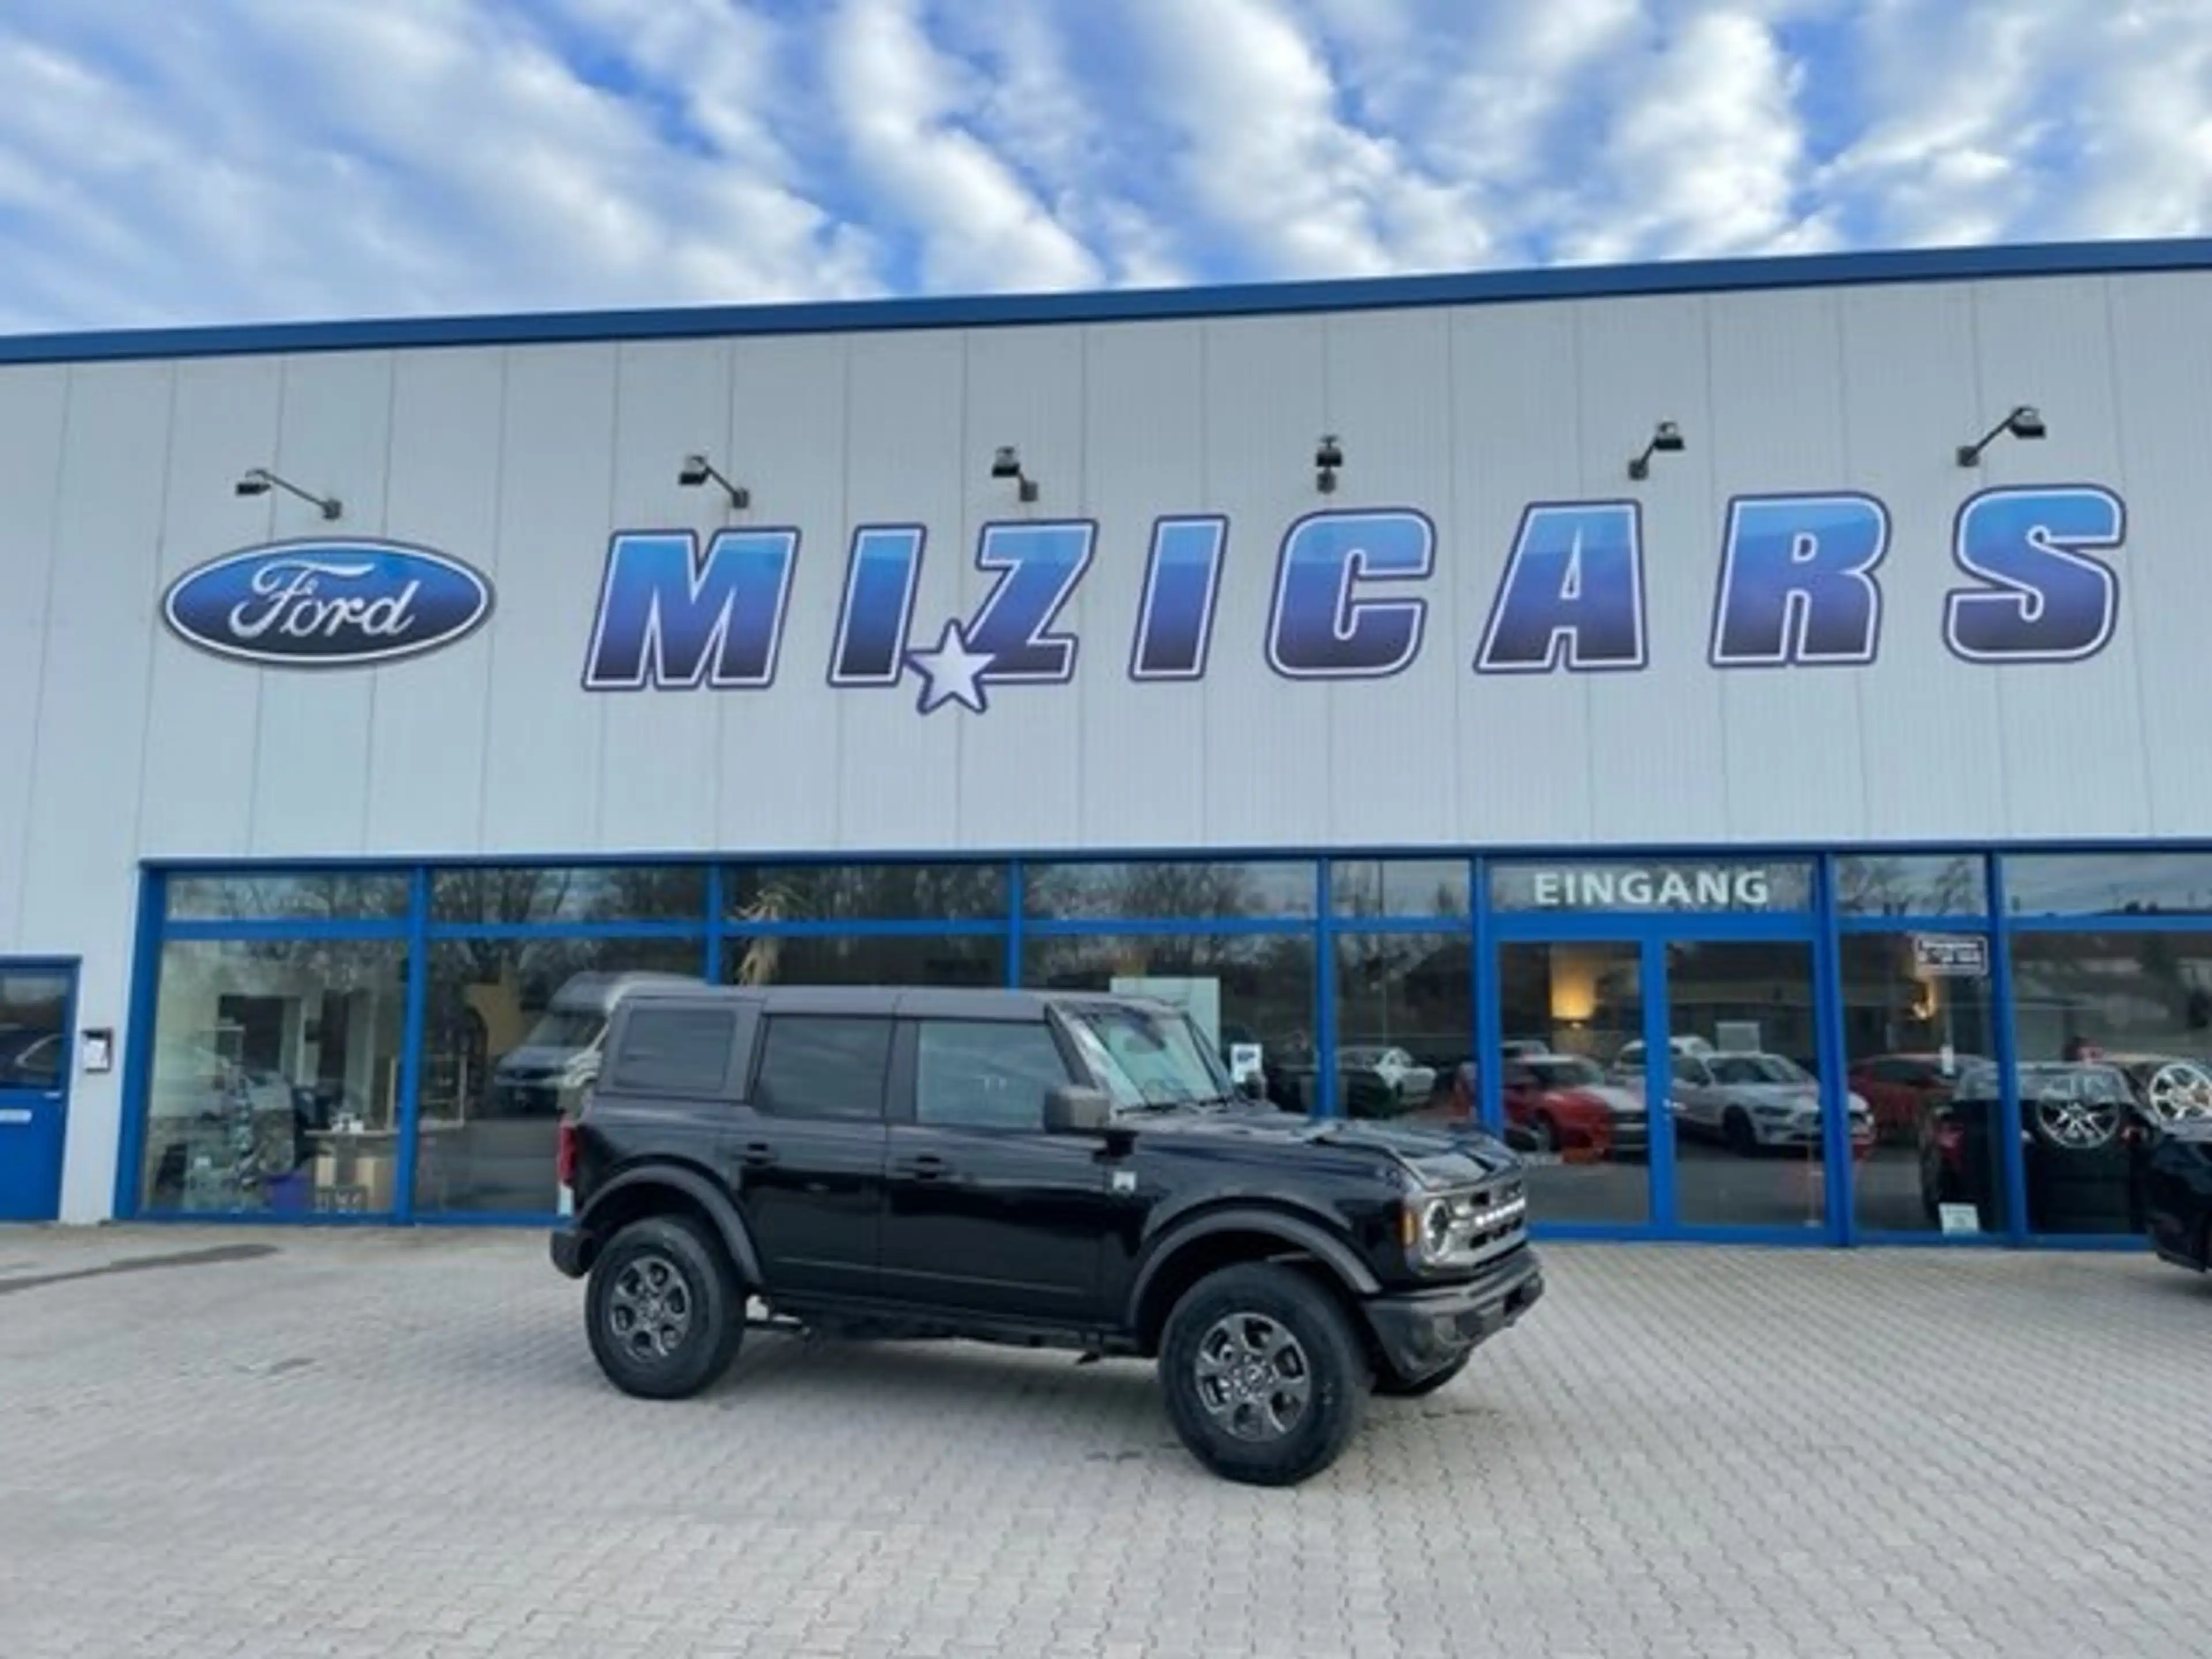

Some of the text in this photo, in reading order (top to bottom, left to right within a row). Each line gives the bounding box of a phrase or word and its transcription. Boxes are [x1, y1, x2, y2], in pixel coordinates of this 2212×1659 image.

[228, 558, 421, 638] Ford
[582, 483, 2127, 690] MIZICARS
[1533, 870, 1768, 905] EINGANG
